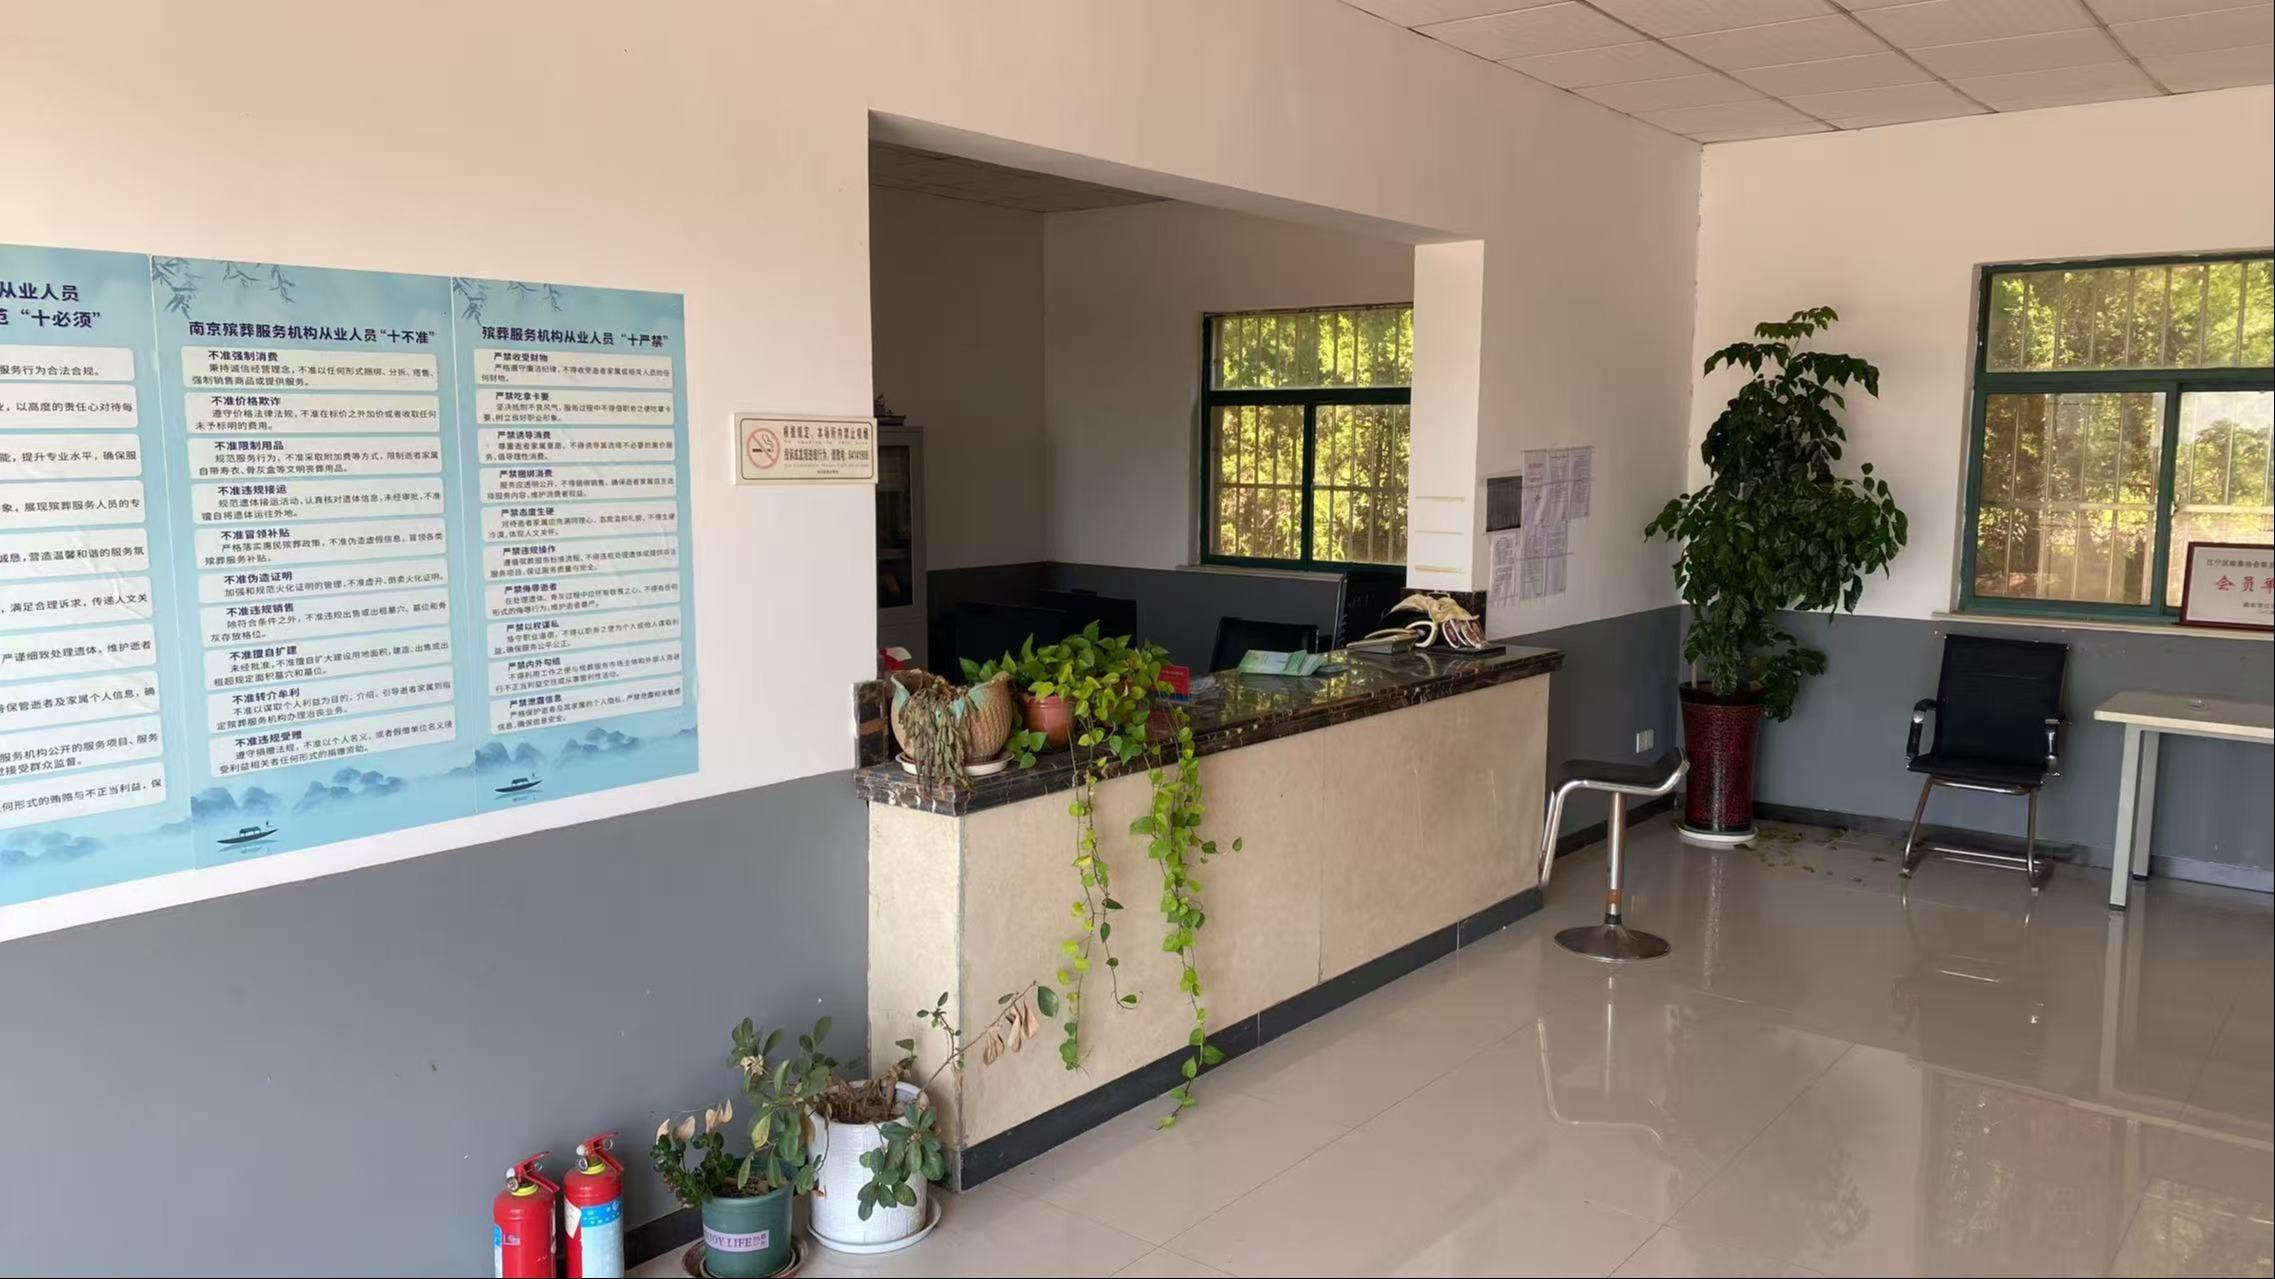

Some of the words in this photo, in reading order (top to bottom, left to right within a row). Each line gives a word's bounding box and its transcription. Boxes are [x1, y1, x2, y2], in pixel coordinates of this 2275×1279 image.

[189, 321, 435, 344] 南京殡葬服务机构从业人员“十不准”
[482, 326, 669, 348] 殡葬服务机构从业人员“十严禁”
[208, 350, 278, 362] 不准强制消费
[494, 352, 548, 362] 严禁收受财物
[191, 375, 309, 387] 强制销售商品或提供服务。
[211, 396, 281, 407] 不准价格欺诈
[495, 392, 549, 401] 严禁吃拿卡要
[195, 420, 273, 430] 未予标明的费用。
[497, 431, 551, 440] 严禁诱导消费
[214, 441, 284, 451] 不准限制用品
[199, 464, 348, 476] 自带寿衣、骨灰盒等文明丧葬用品。
[499, 469, 553, 479] 严禁捆绑消费
[218, 484, 287, 496] 不准违规接运
[2, 499, 140, 513] 象，展现殡葬服务人员的专
[201, 510, 298, 521] 擅自将遗体运往外地。
[501, 507, 554, 518] 严禁态度生硬
[220, 528, 290, 541] 不准冒领补贴
[503, 545, 556, 556] 严禁违规操作
[204, 554, 271, 566] 殡葬服务补贴。
[224, 571, 293, 585] 不准伪造证明
[504, 582, 557, 594] 严禁侮辱逝者
[226, 603, 294, 617] 不准违规销售
[506, 619, 559, 632] 严禁以权谋私
[210, 631, 267, 643] 灰存放格位。
[229, 645, 298, 661] 不准擅自扩建
[508, 658, 561, 670] 严禁内外勾结
[214, 668, 327, 687] 租超规定面积墓穴和墓位。
[232, 688, 300, 704] 不准转介牟利
[509, 694, 562, 708] 严禁泄露信息
[216, 708, 348, 731] 定殡葬服务机构办理治丧业务。
[235, 731, 302, 748] 不准违规受赠
[727, 1237, 752, 1248] LIFE
